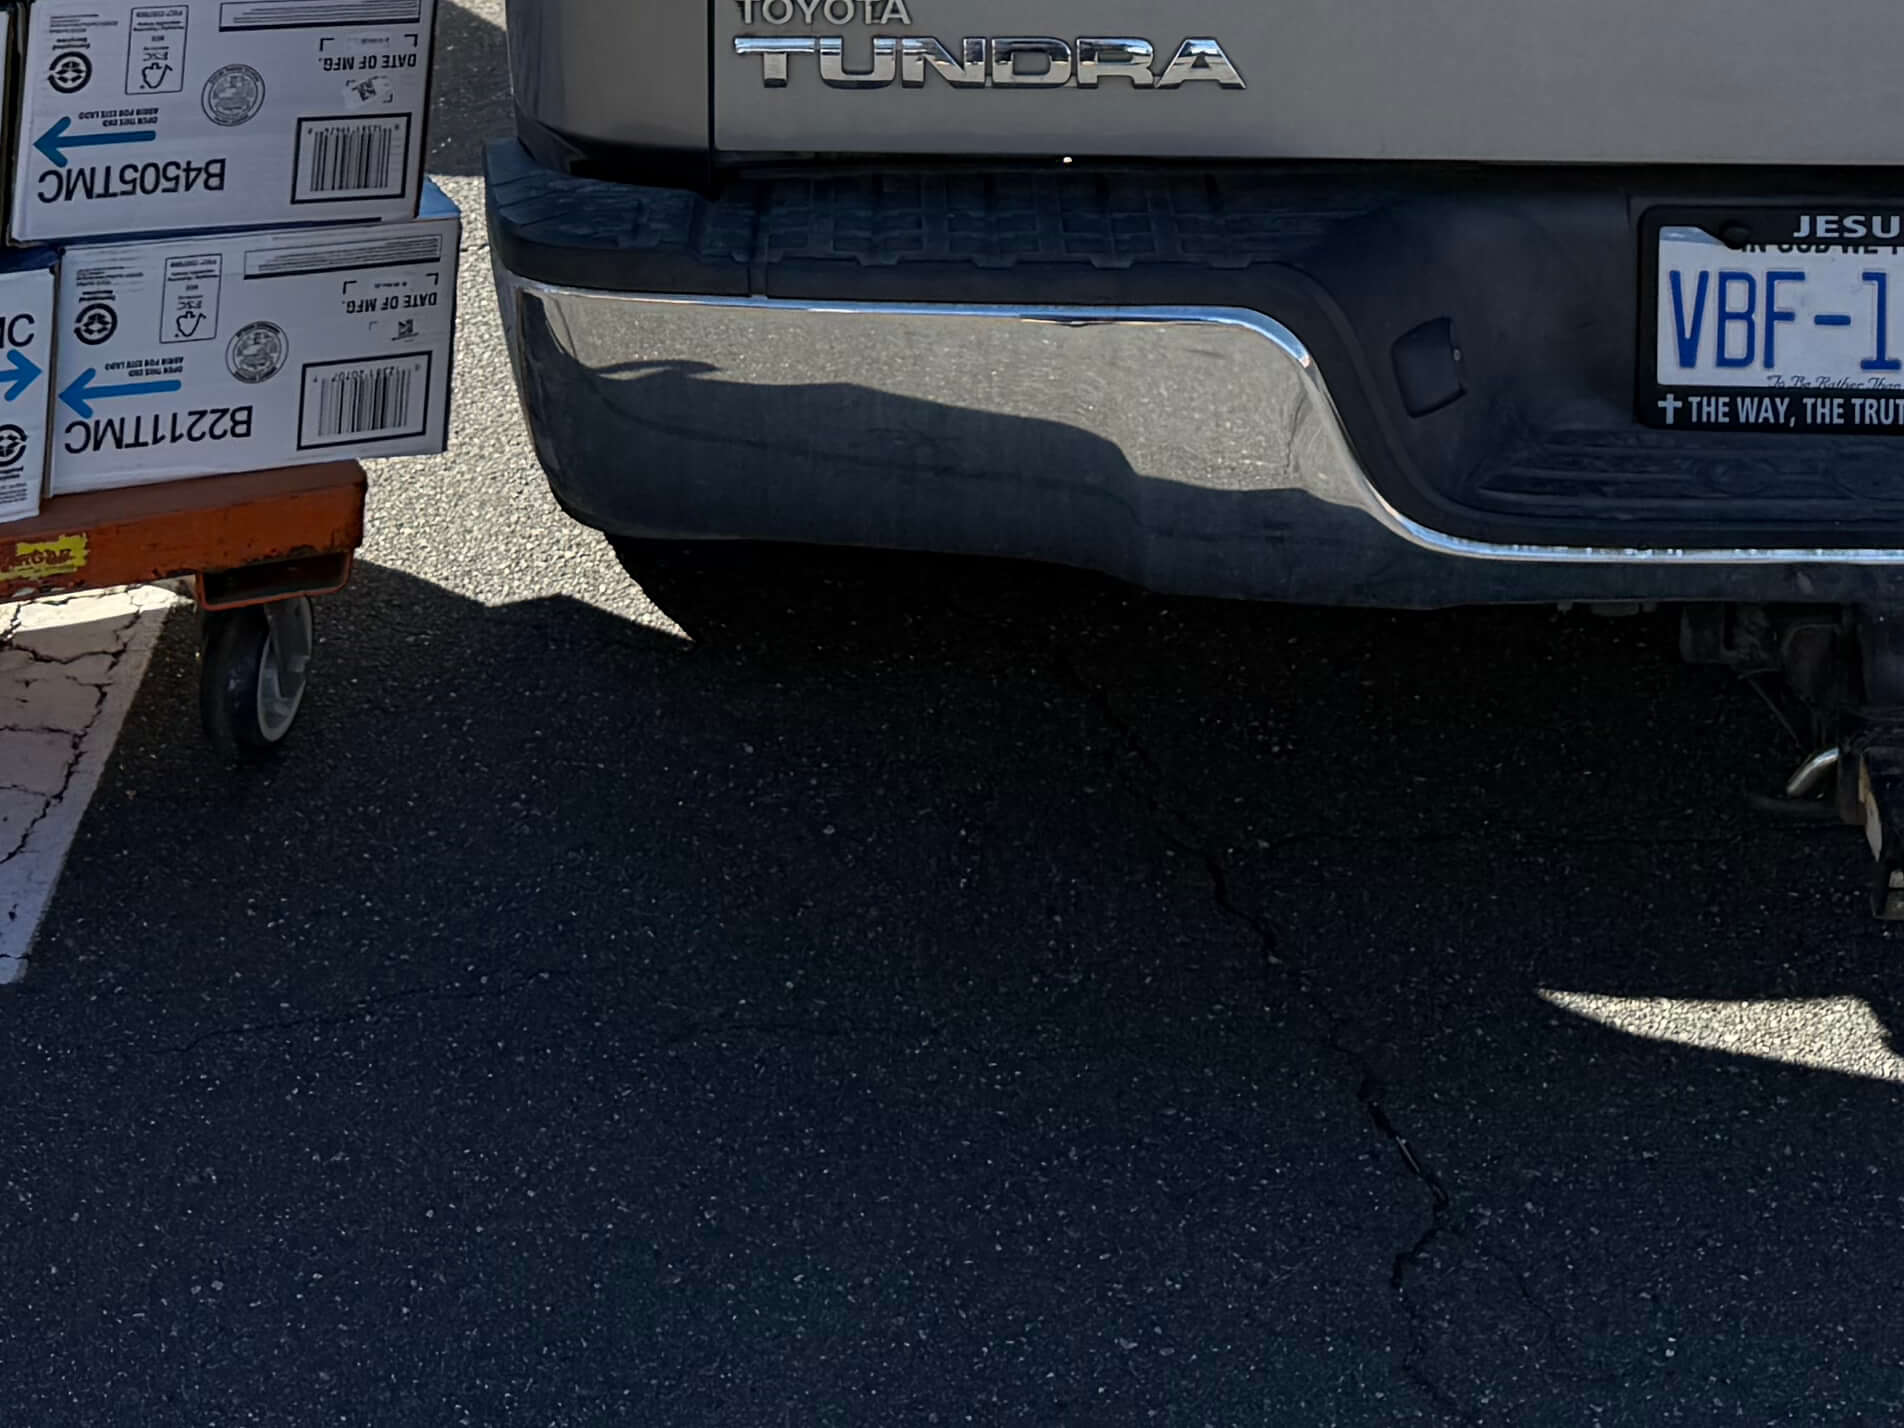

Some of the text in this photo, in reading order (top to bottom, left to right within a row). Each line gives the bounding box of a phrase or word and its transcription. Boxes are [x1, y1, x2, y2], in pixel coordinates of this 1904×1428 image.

[318, 53, 416, 72] DATE OF MFG.
[734, 36, 1246, 89] TUNDRA
[37, 158, 227, 204] B4505TMC
[341, 291, 437, 314] DATE OF MFG.
[64, 404, 254, 455] B2211TMC
[1688, 395, 1730, 424] THE
[1736, 396, 1795, 428] WAY,
[1802, 397, 1844, 425] THE
